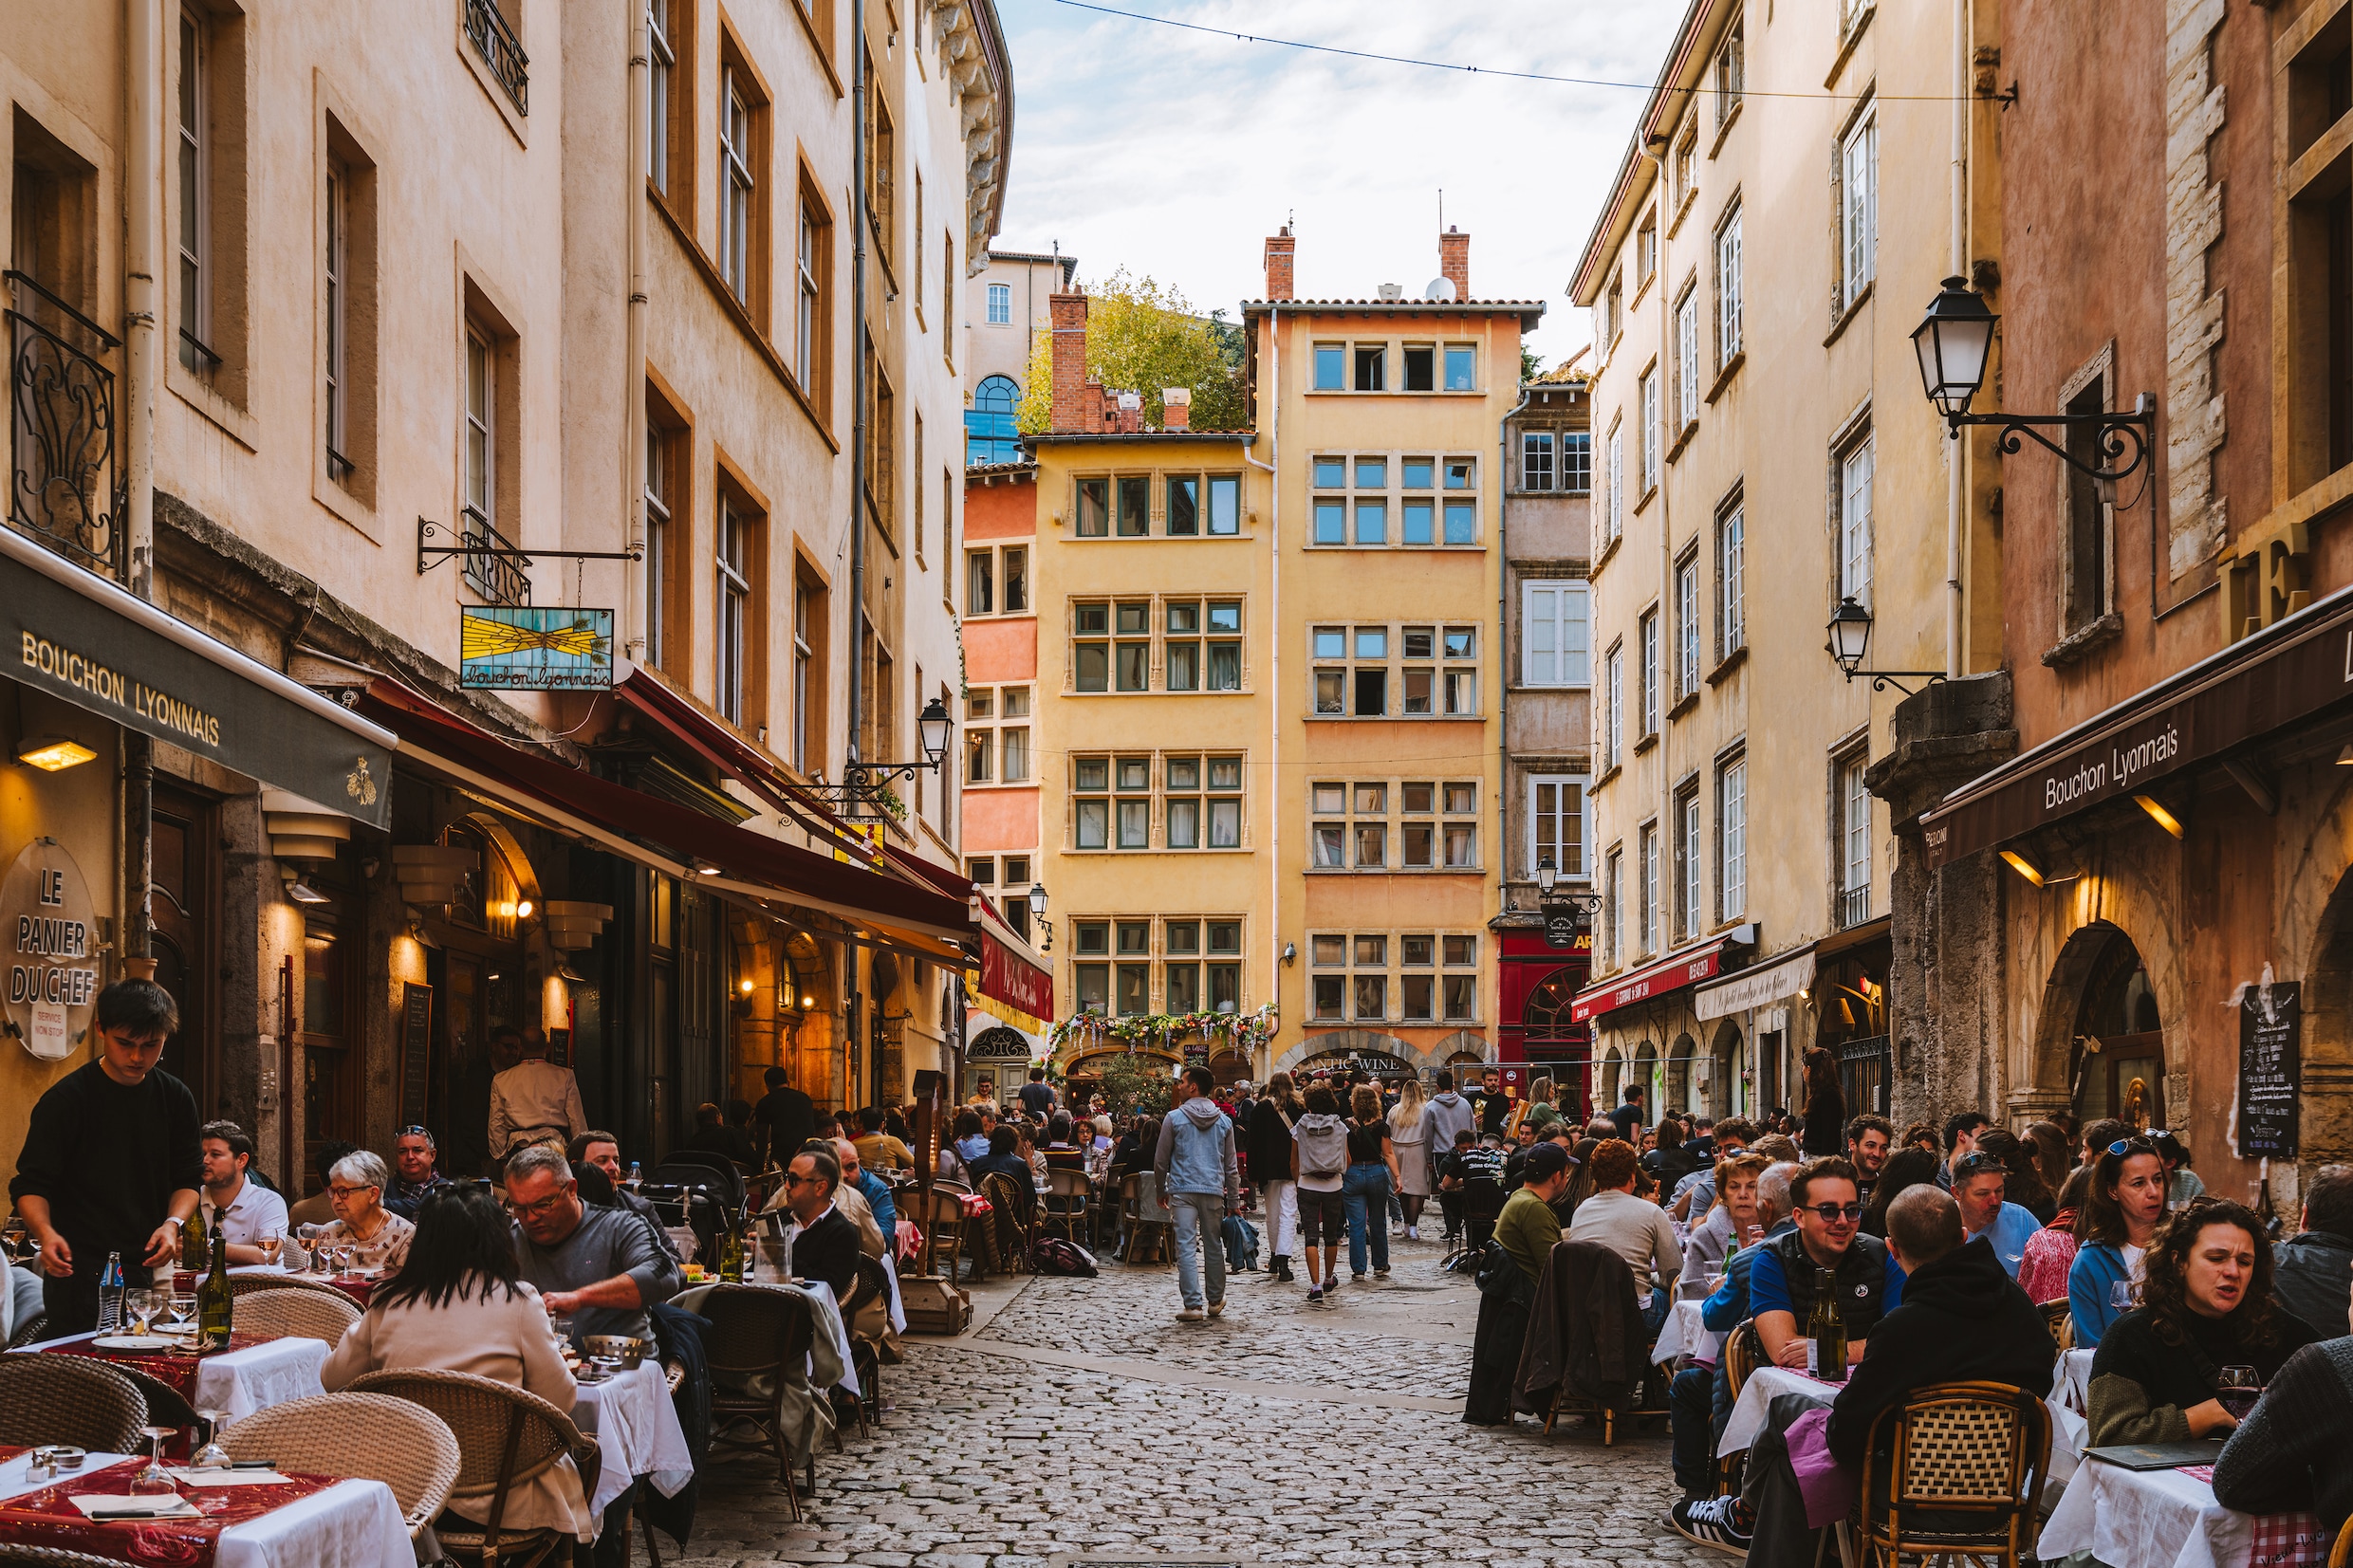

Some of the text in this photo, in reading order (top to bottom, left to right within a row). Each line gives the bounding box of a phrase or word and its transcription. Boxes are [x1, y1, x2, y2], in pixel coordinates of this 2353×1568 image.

[22, 630, 220, 747] BOUCHON LYONNAIS
[463, 665, 610, 690] bouchon lyonnais
[2045, 723, 2178, 810] Bouchon Lyonnais
[1926, 826, 1948, 847] PERONI
[1930, 847, 1943, 858] ITALY
[40, 868, 63, 907] LE
[17, 914, 85, 958] PANIER
[10, 965, 94, 1006] DU CHEF
[37, 1010, 62, 1024] SERVICE
[35, 1025, 64, 1038] NON STOP
[1306, 1058, 1399, 1070] ANTIC WINE
